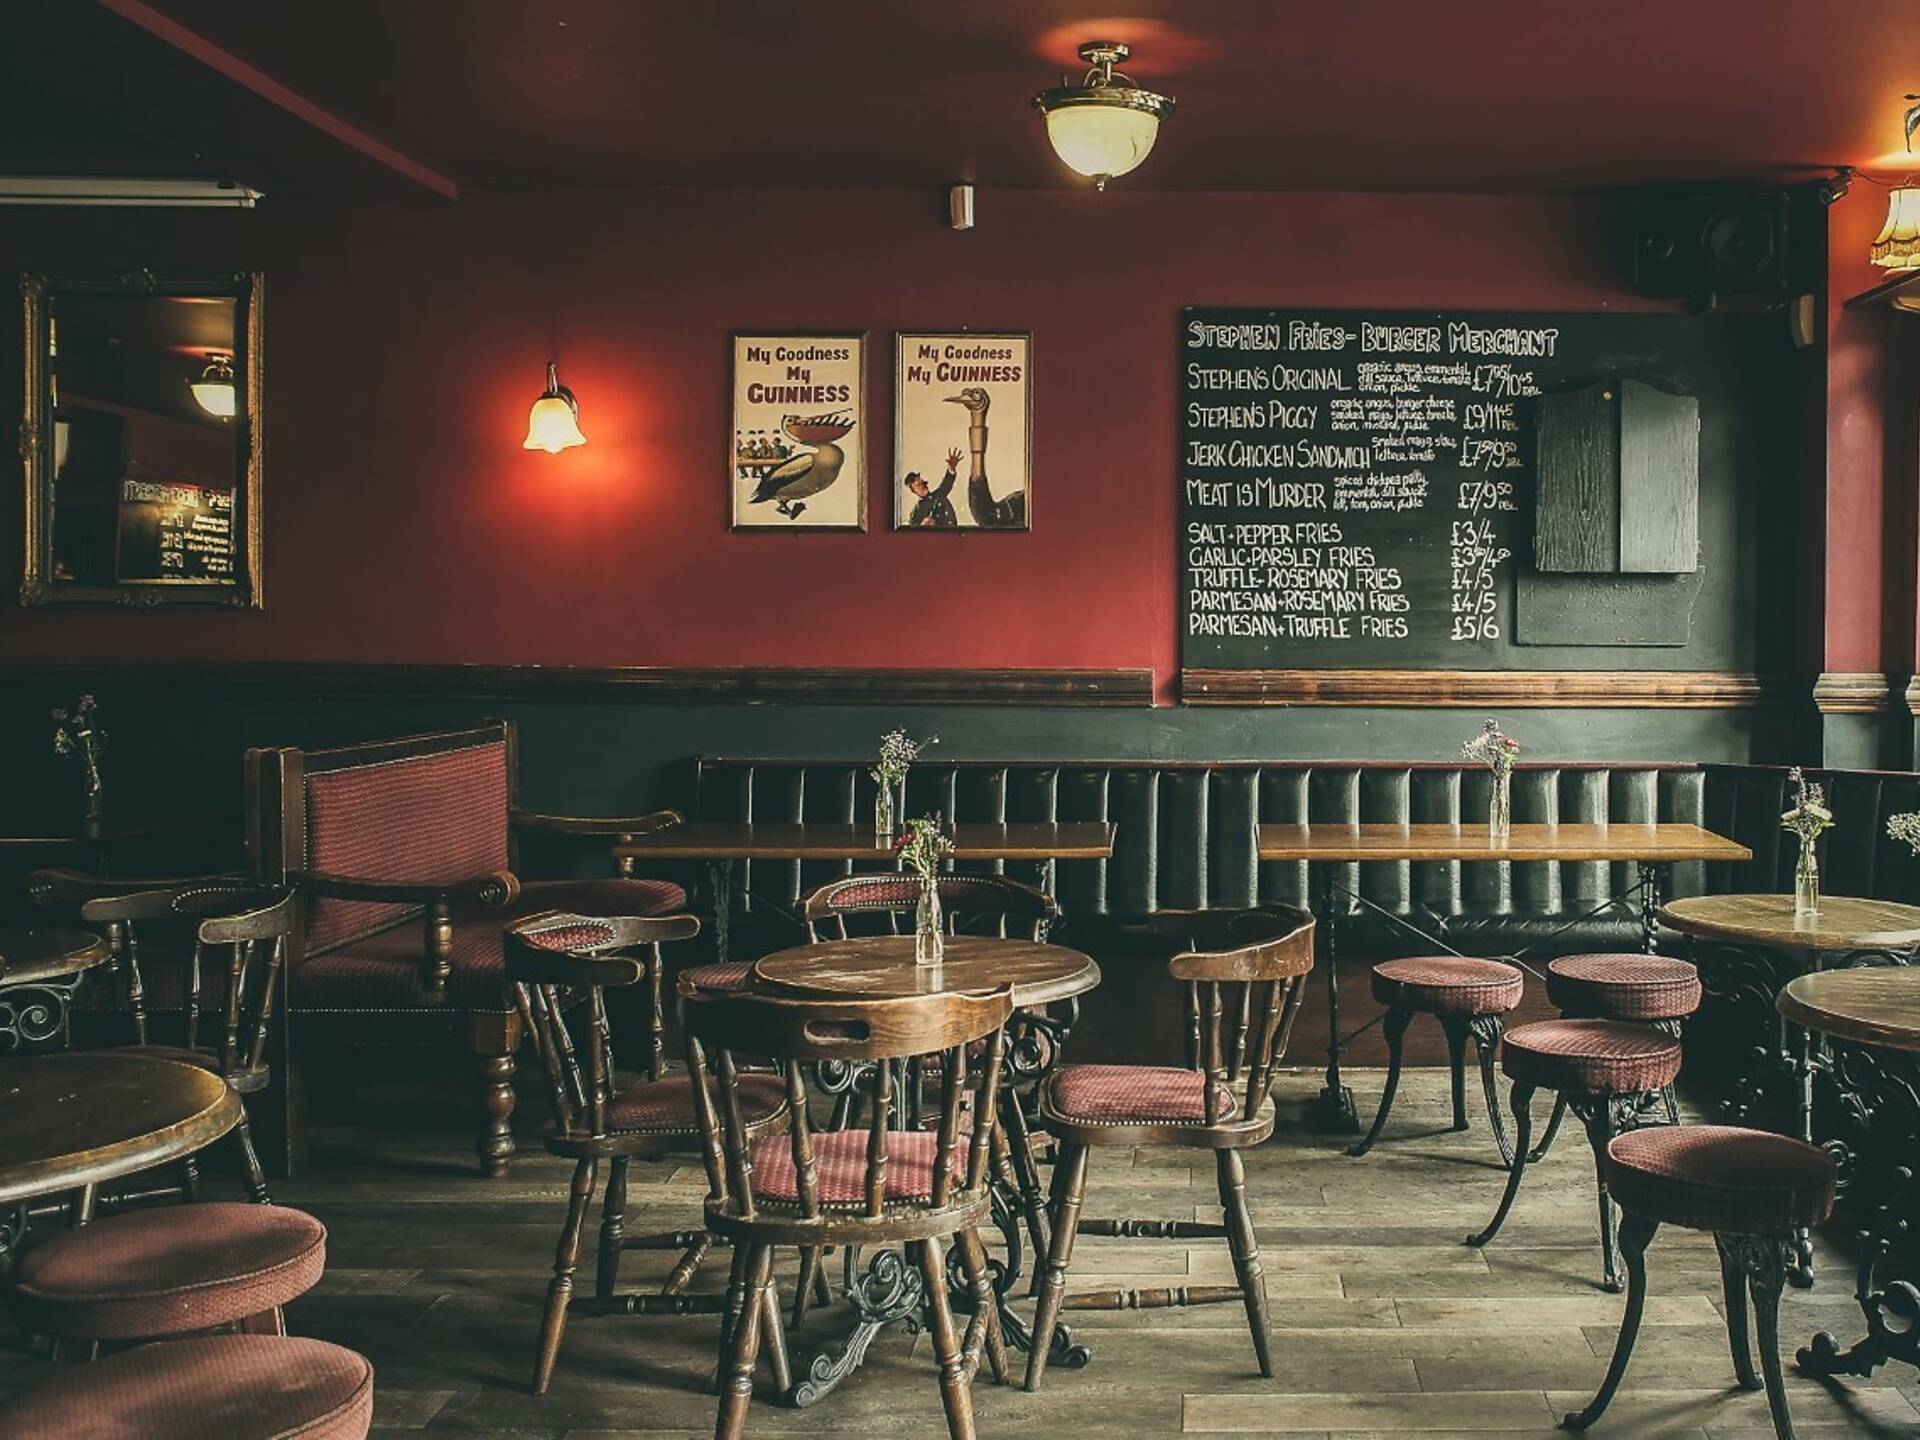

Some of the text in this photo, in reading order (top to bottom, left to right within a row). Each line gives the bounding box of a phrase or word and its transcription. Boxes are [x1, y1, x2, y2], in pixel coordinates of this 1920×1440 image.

[747, 346, 850, 364] My Goodness
[917, 345, 1013, 363] My Goodness
[786, 366, 811, 384] My
[907, 363, 1022, 385] My GUINNESS
[747, 383, 850, 403] GUINNESS
[1187, 438, 1370, 469] JERK CHICKEN SANDWICH
[1186, 477, 1233, 506] MEAT
[1296, 522, 1342, 544] FRIES
[1329, 547, 1375, 568] FRIES
[1355, 568, 1402, 590] FRIES
[1369, 590, 1410, 612] FRIES
[1360, 615, 1408, 638] FRIES
